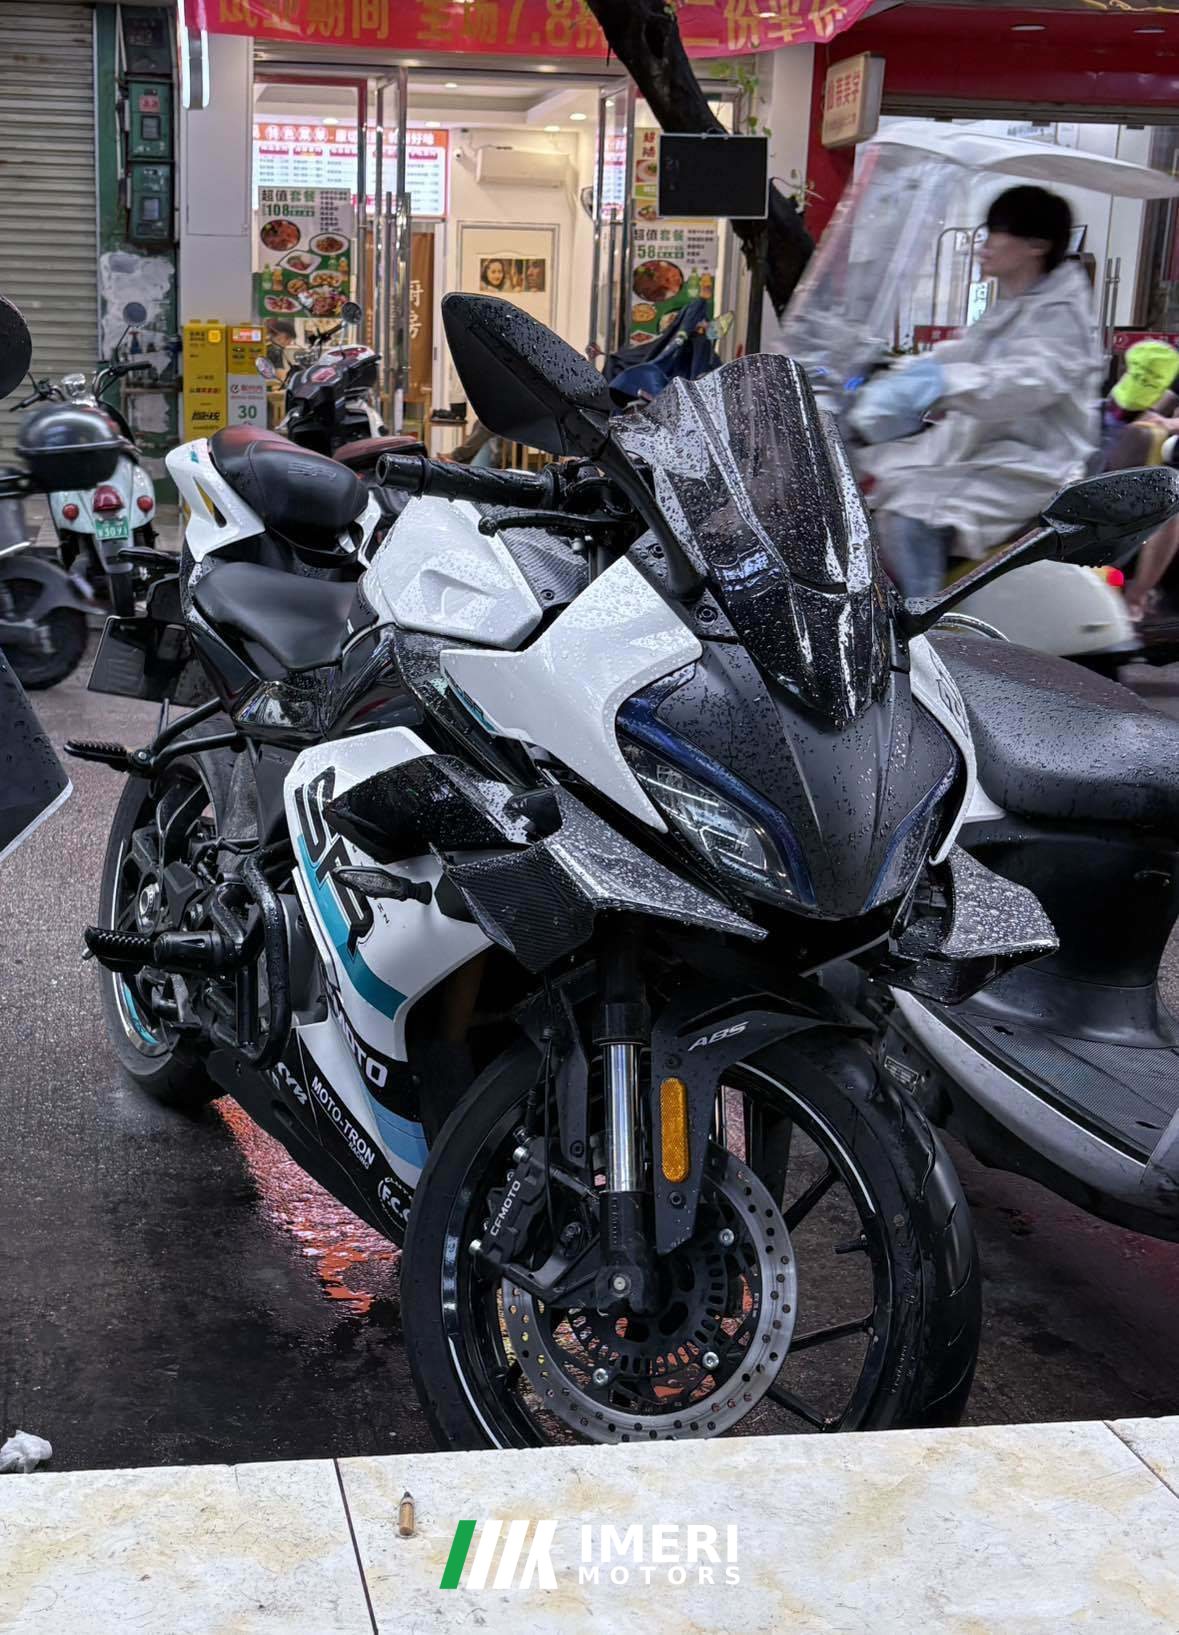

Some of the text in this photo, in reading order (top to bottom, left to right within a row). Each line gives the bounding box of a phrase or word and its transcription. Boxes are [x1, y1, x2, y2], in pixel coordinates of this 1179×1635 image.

[262, 189, 316, 202] 超值套餐
[268, 204, 289, 217] 108
[634, 229, 684, 241] 超值套餐
[637, 245, 656, 259] 58
[237, 405, 258, 419] 30
[687, 1020, 750, 1052] ABS
[310, 1075, 376, 1166] MOTO-TRON
[489, 1180, 521, 1237] CFMOTO
